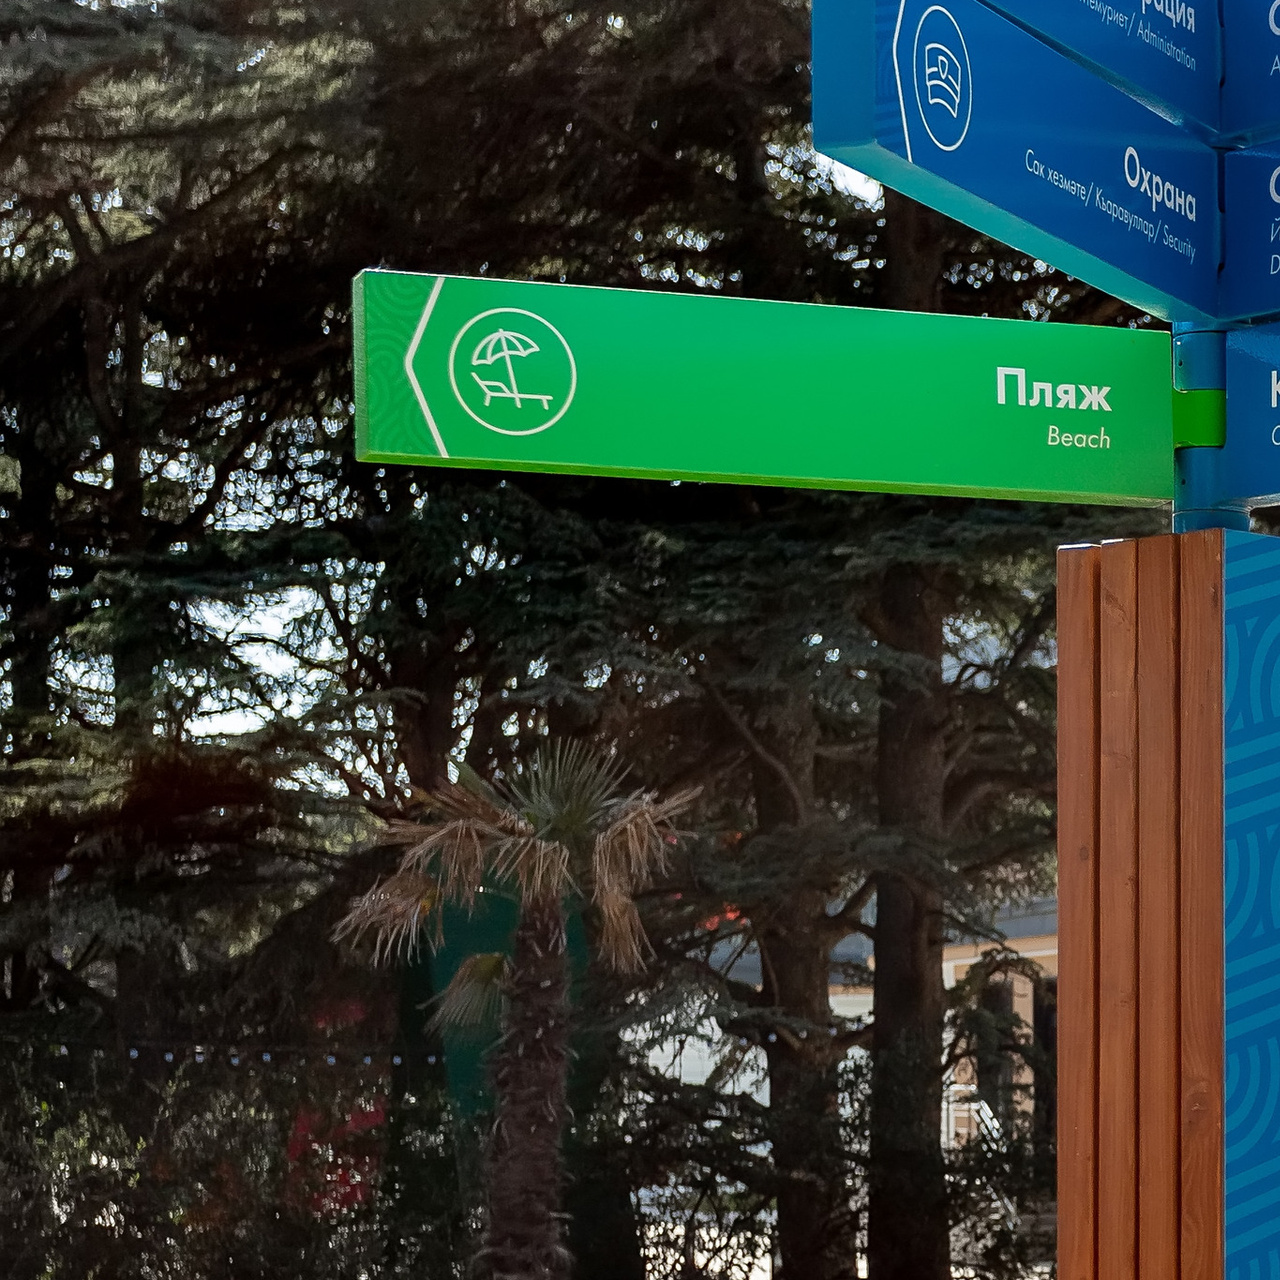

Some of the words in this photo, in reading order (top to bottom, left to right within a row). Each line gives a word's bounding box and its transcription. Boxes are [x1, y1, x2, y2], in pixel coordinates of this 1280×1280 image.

[1137, 19, 1196, 72] Administration
[1025, 149, 1045, 178] Сак
[1047, 167, 1094, 207] хезмәте/
[1095, 187, 1162, 244] Къаравуллар/
[1124, 146, 1196, 222] Охрана
[1162, 224, 1196, 265] Security
[996, 366, 1113, 412] Пляж
[1047, 424, 1111, 449] Beach
